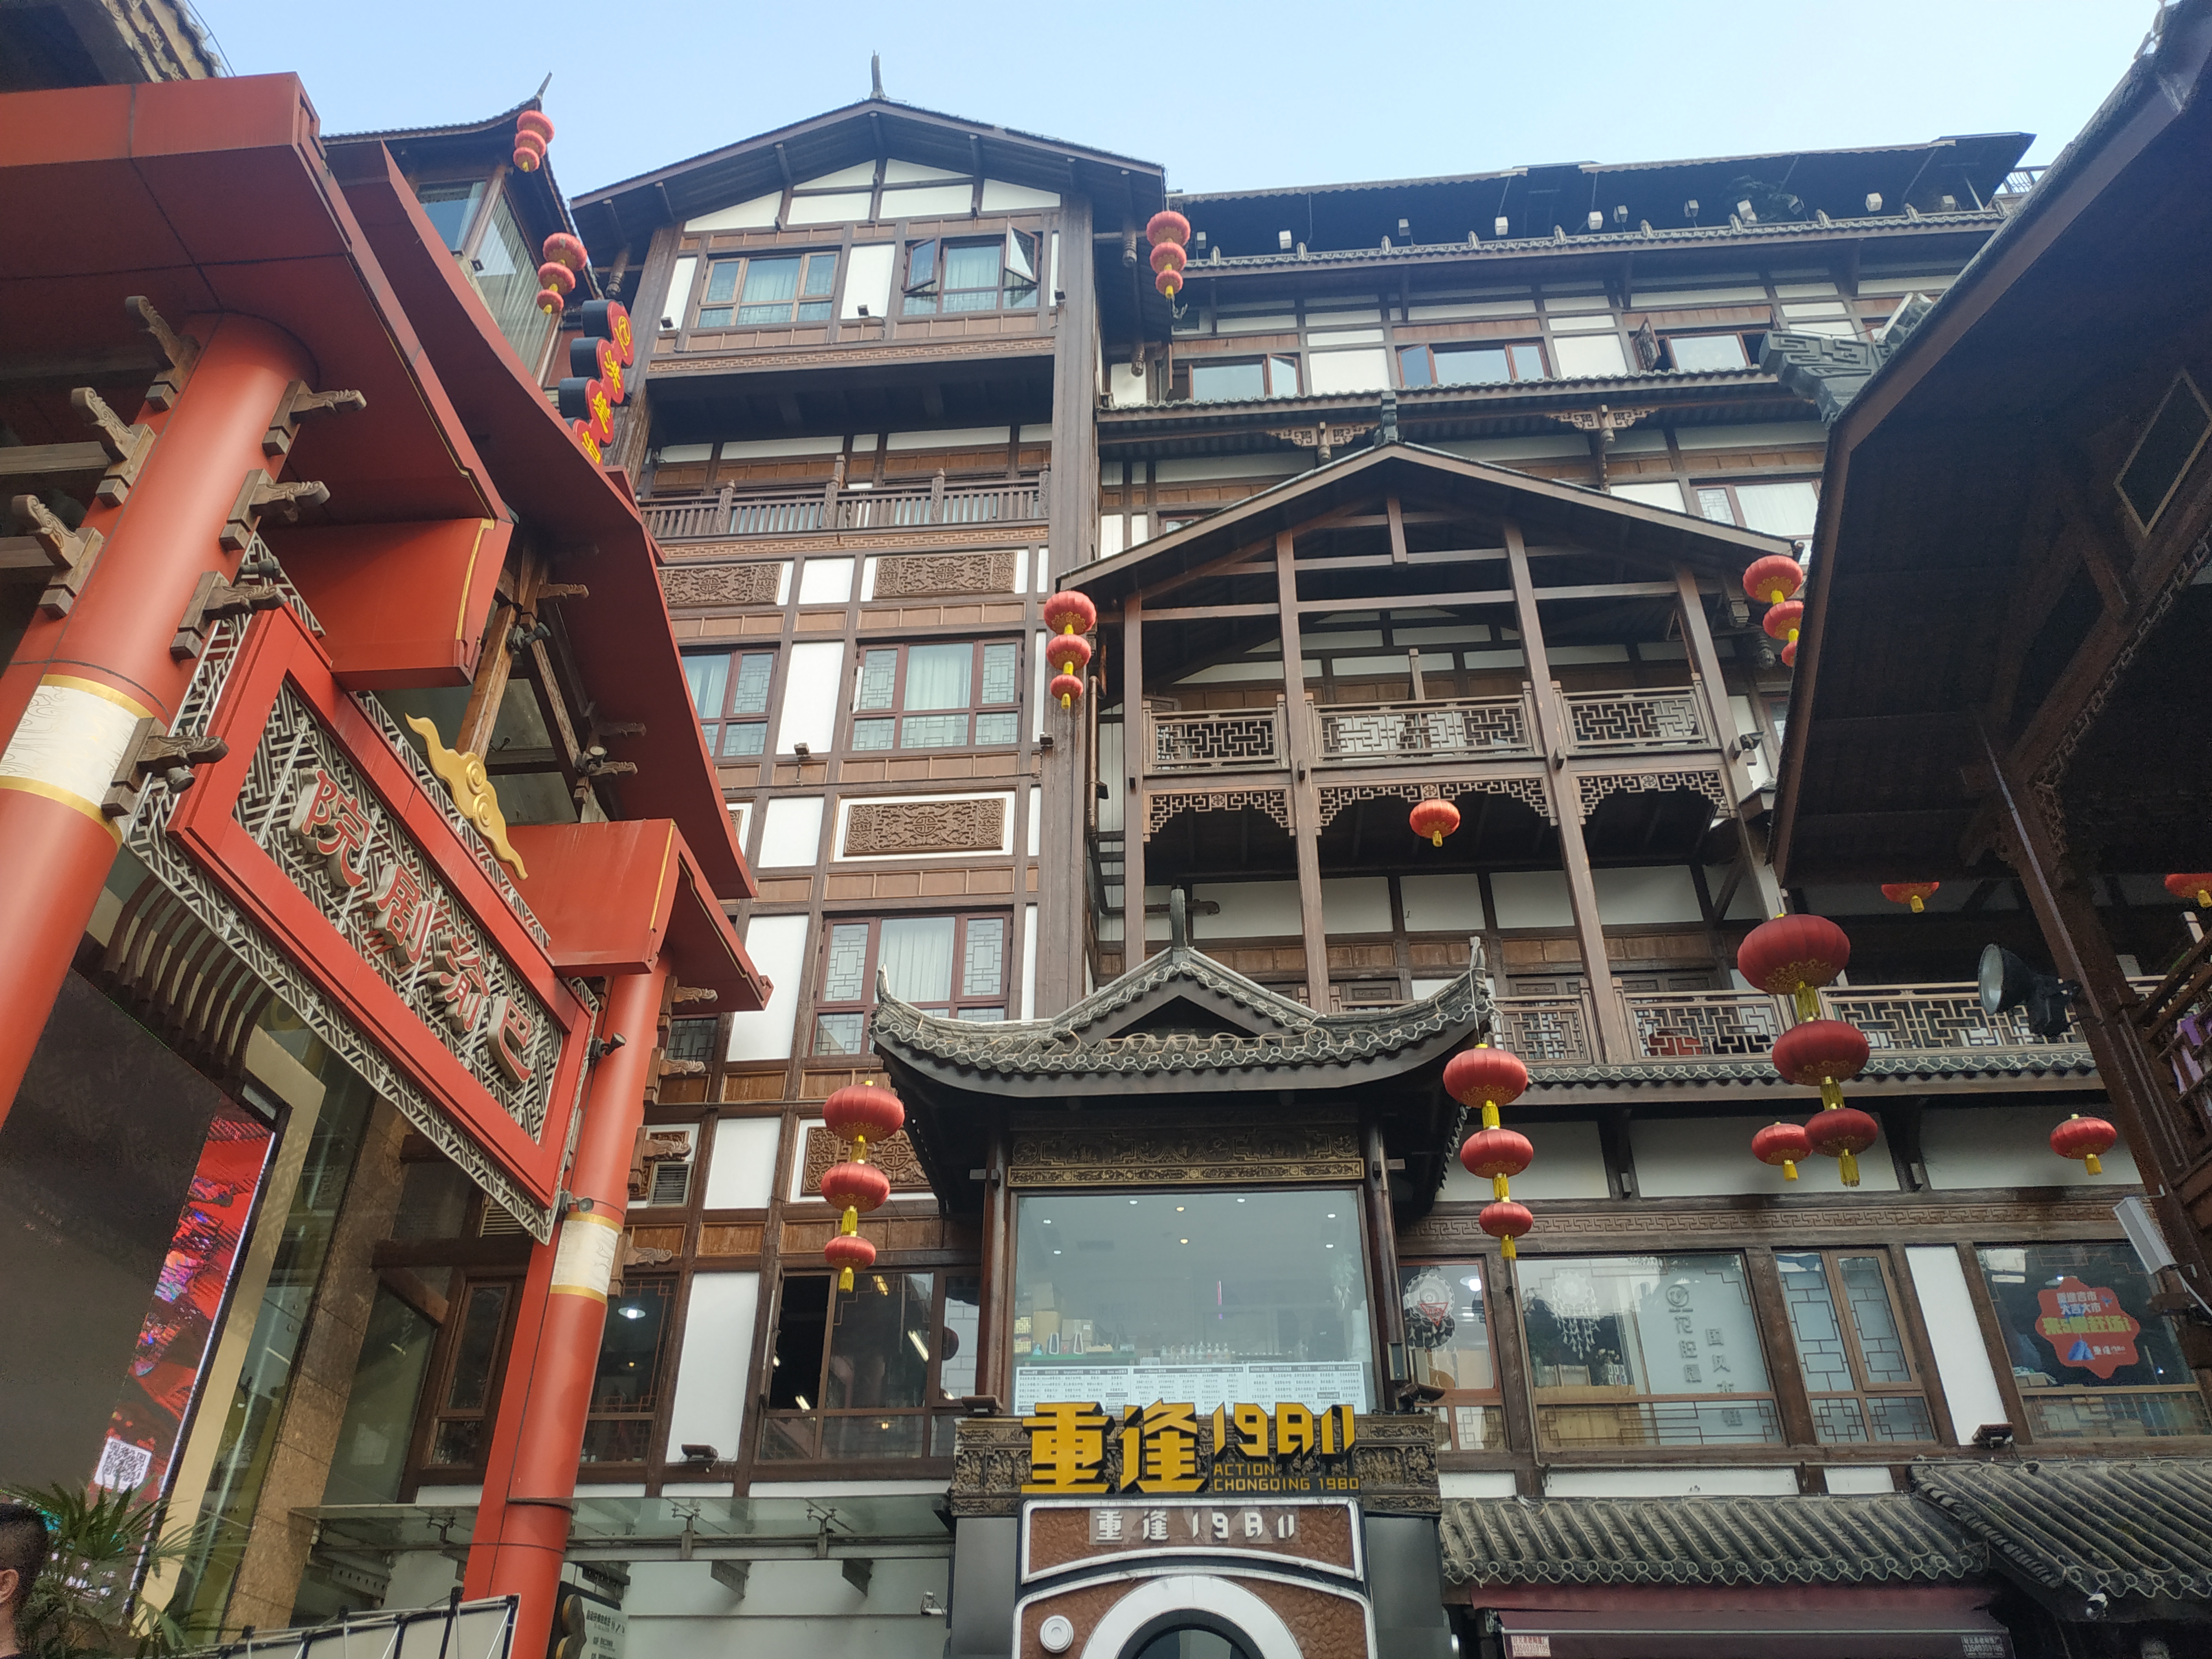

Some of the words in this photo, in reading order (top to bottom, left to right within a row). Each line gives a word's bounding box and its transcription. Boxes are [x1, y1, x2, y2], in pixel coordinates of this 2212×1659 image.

[1214, 1463, 1275, 1476] ACTION
[1214, 1477, 1311, 1492] CHONGQING
[1319, 1477, 1359, 1491] 1980
